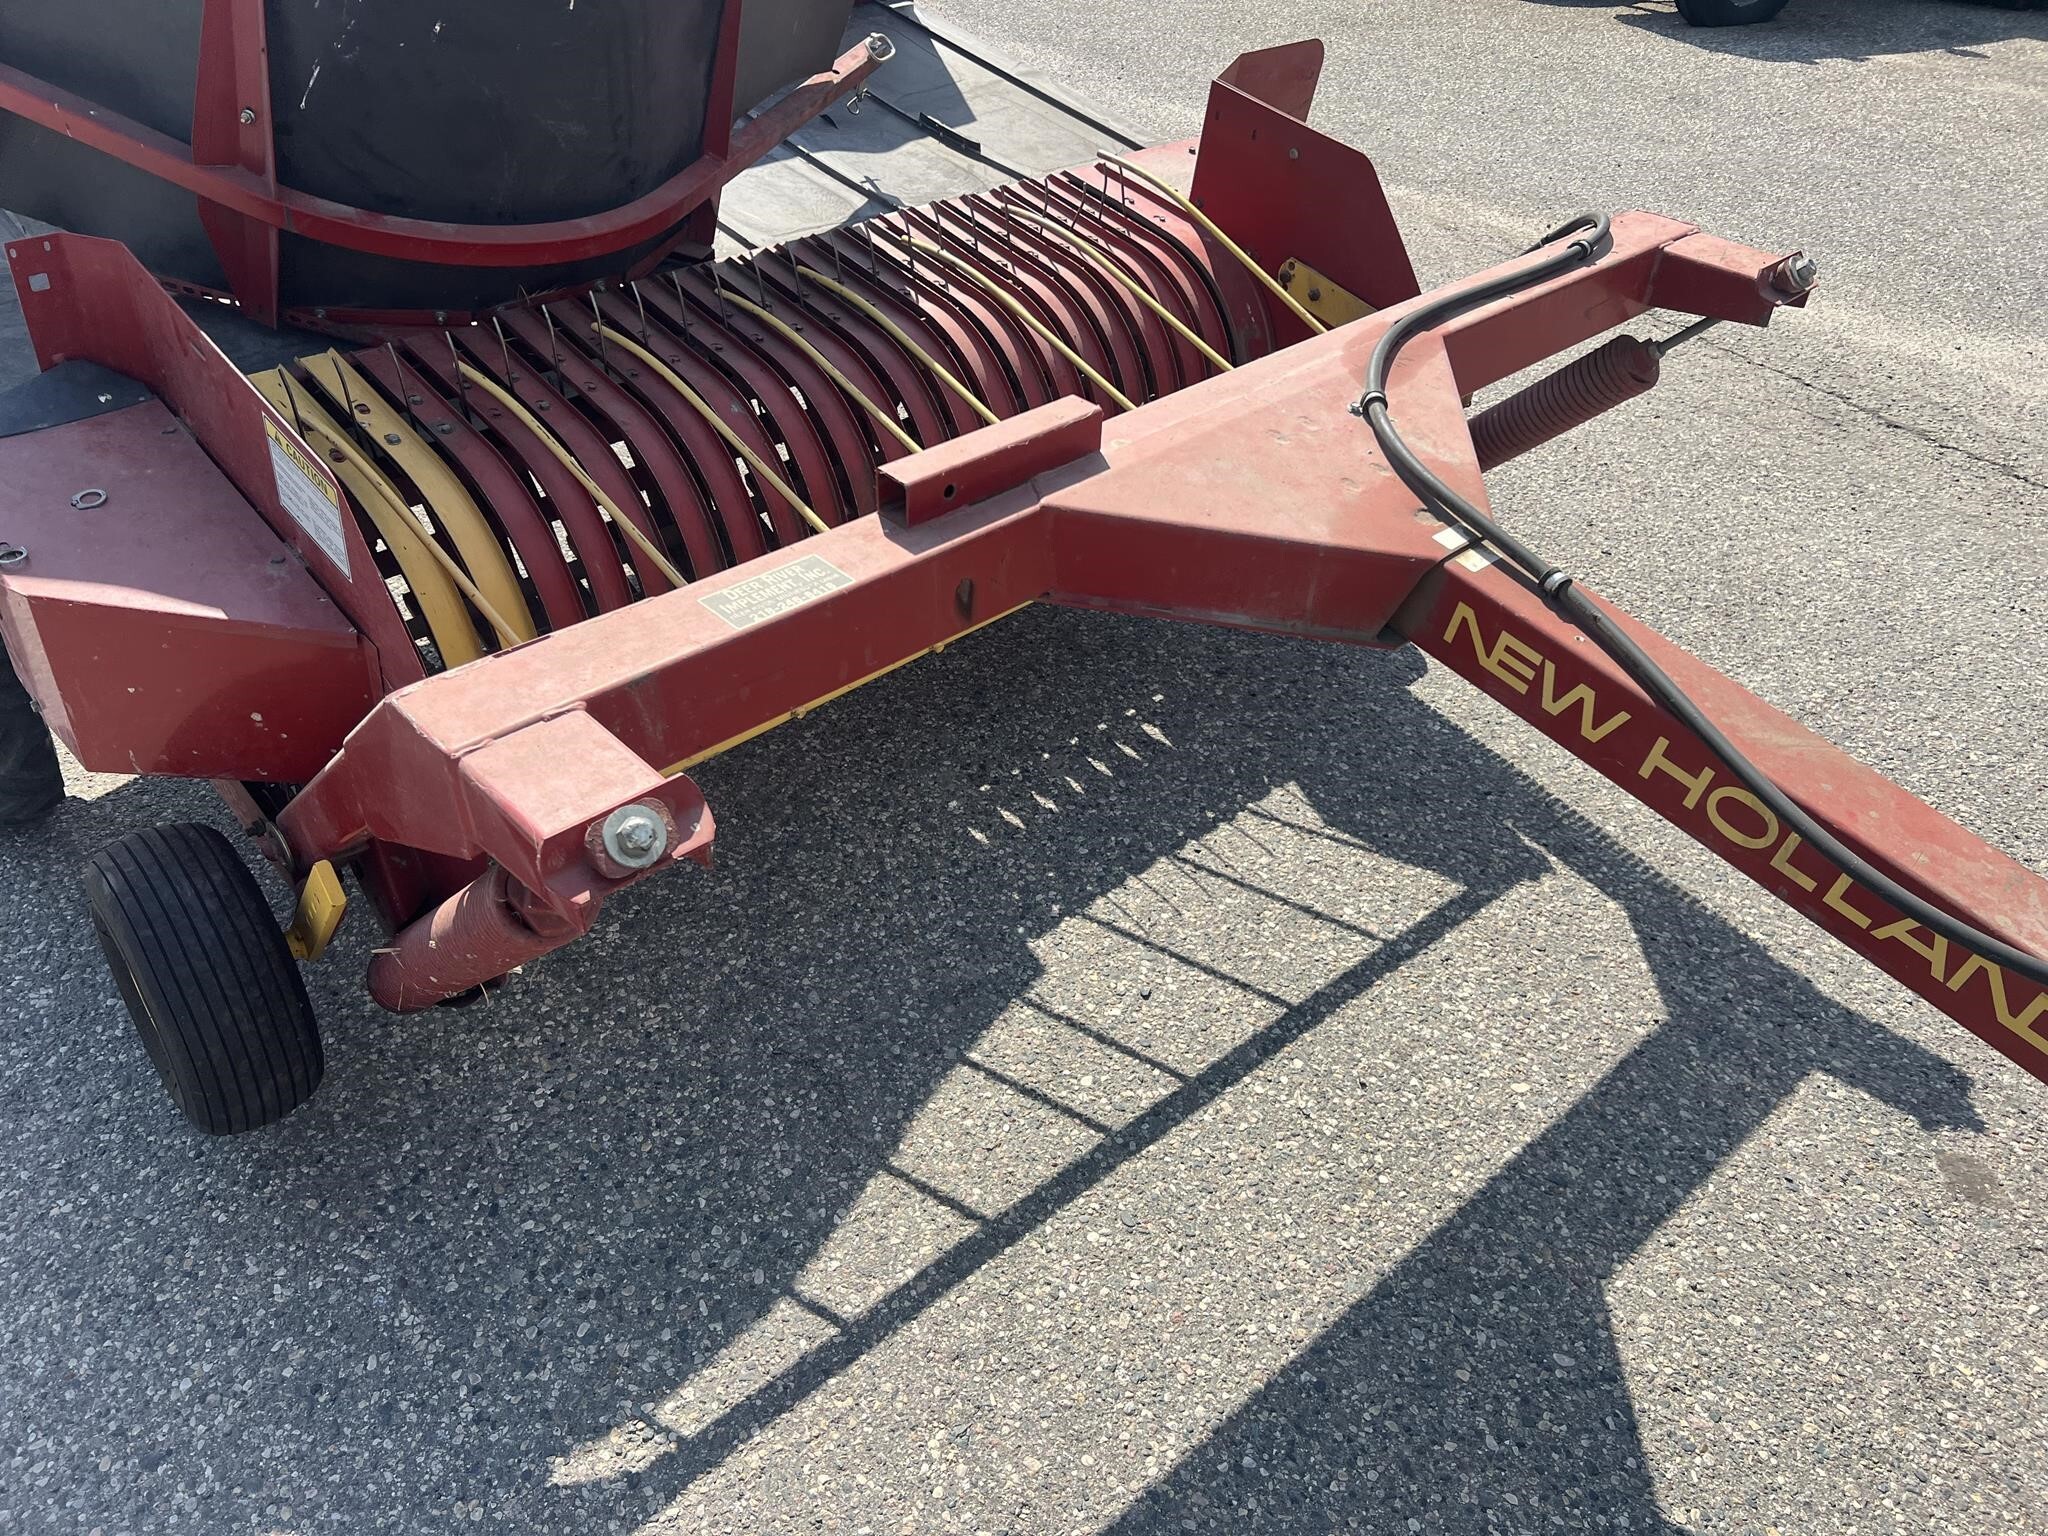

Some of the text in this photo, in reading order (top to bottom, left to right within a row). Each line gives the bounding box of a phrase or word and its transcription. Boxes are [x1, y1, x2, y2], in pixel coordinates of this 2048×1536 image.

[285, 441, 329, 496] CAUTION
[718, 577, 804, 614] IMPLEMENT,
[799, 567, 831, 587] INC.
[723, 580, 764, 601] DEER
[761, 564, 806, 589] RIVER
[1442, 600, 1632, 744] NEW
